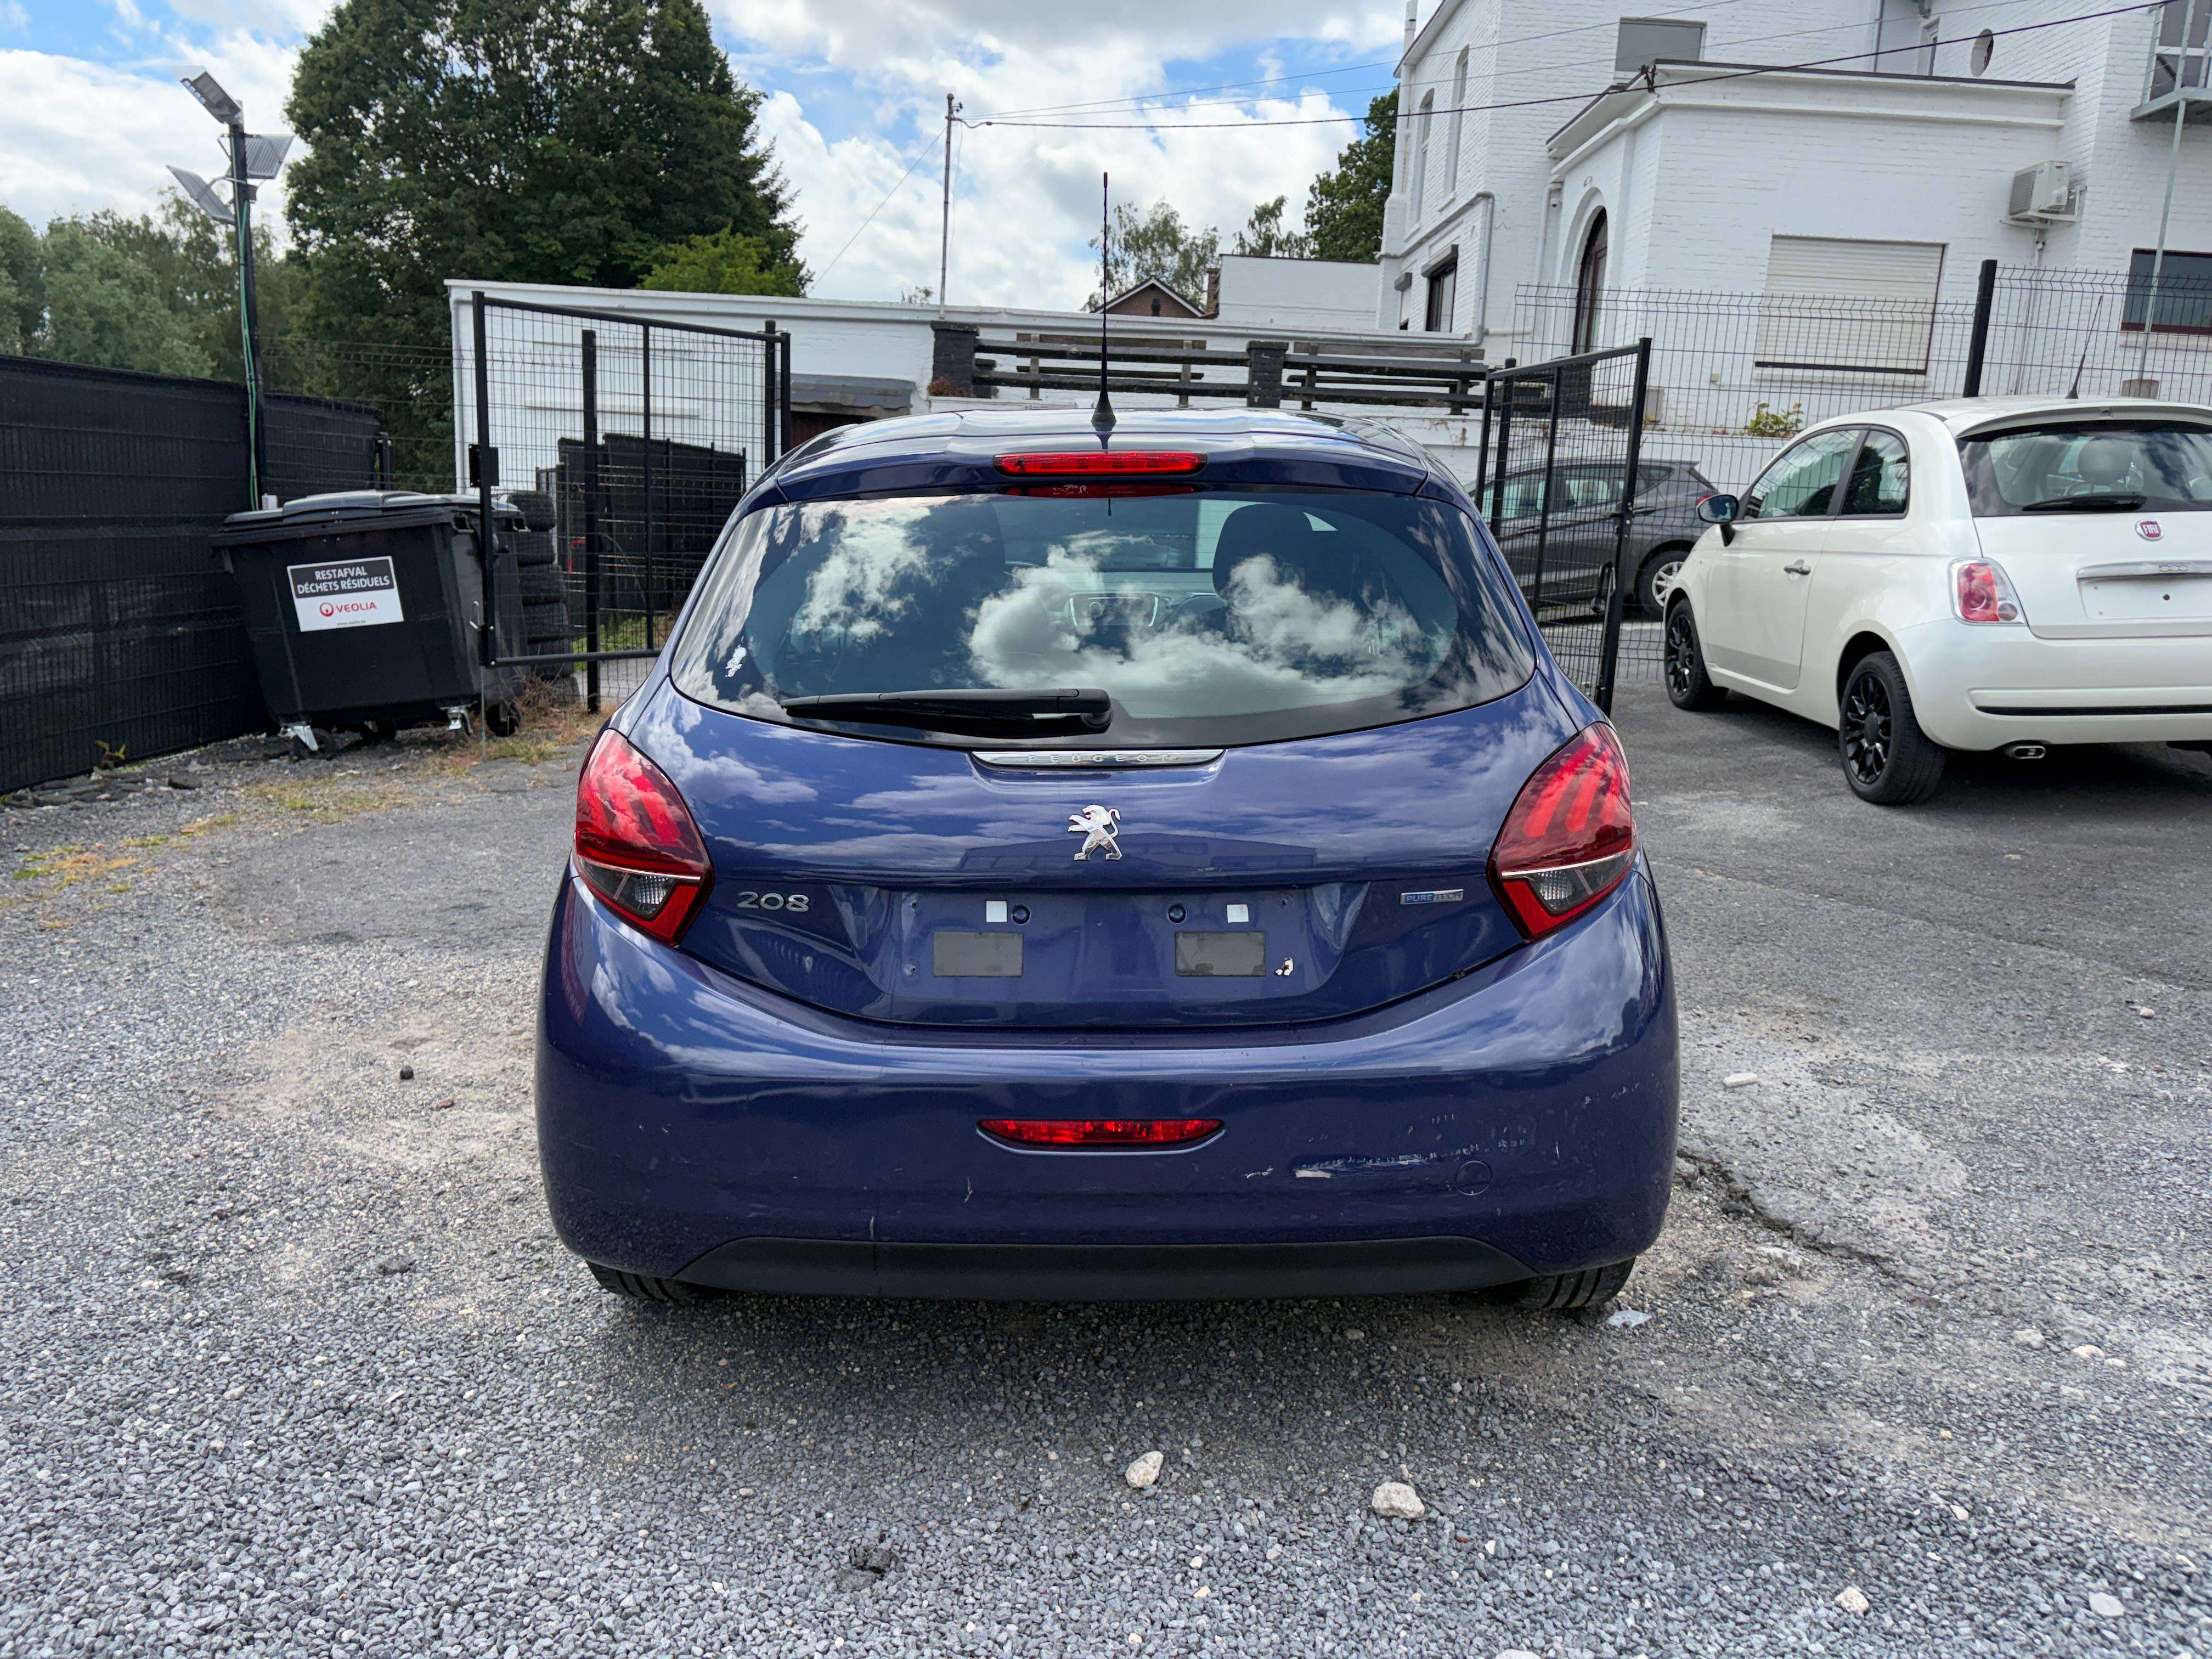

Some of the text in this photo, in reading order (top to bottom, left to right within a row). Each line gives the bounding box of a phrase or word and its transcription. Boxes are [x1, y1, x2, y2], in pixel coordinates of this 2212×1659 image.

[2142, 524, 2159, 535] FIAT
[314, 566, 368, 580] RESTAFVAL
[297, 575, 391, 595] DÉCHETS RÉSIDUELS
[336, 601, 377, 613] VEOLIA
[1028, 753, 1170, 763] PEUGEOT
[737, 891, 810, 912] 208
